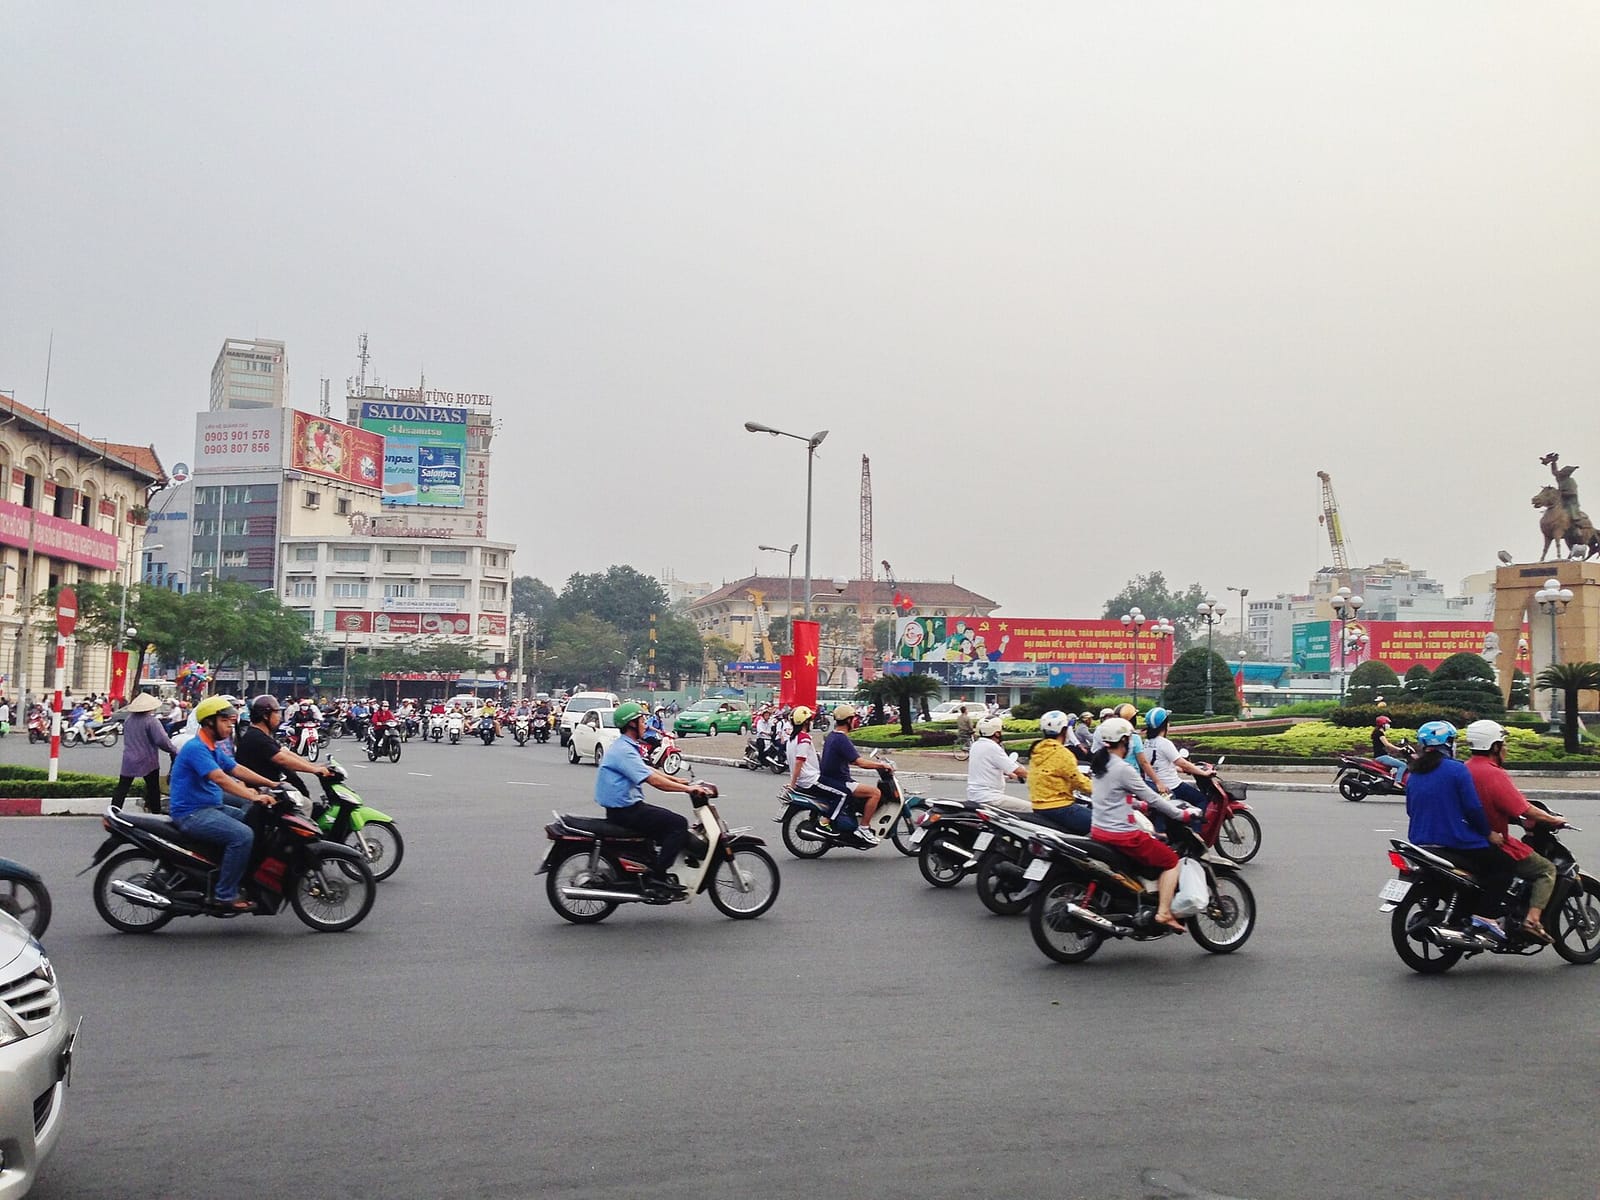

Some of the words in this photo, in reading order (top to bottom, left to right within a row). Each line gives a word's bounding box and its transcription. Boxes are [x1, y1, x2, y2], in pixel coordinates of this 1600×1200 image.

[456, 392, 492, 406] HOTEL
[204, 431, 229, 442] 0903
[231, 430, 248, 441] 901
[252, 429, 270, 440] 578
[204, 444, 228, 455] 0903
[230, 443, 249, 454] 807
[251, 442, 270, 453] 856
[420, 468, 457, 480] Salonpas
